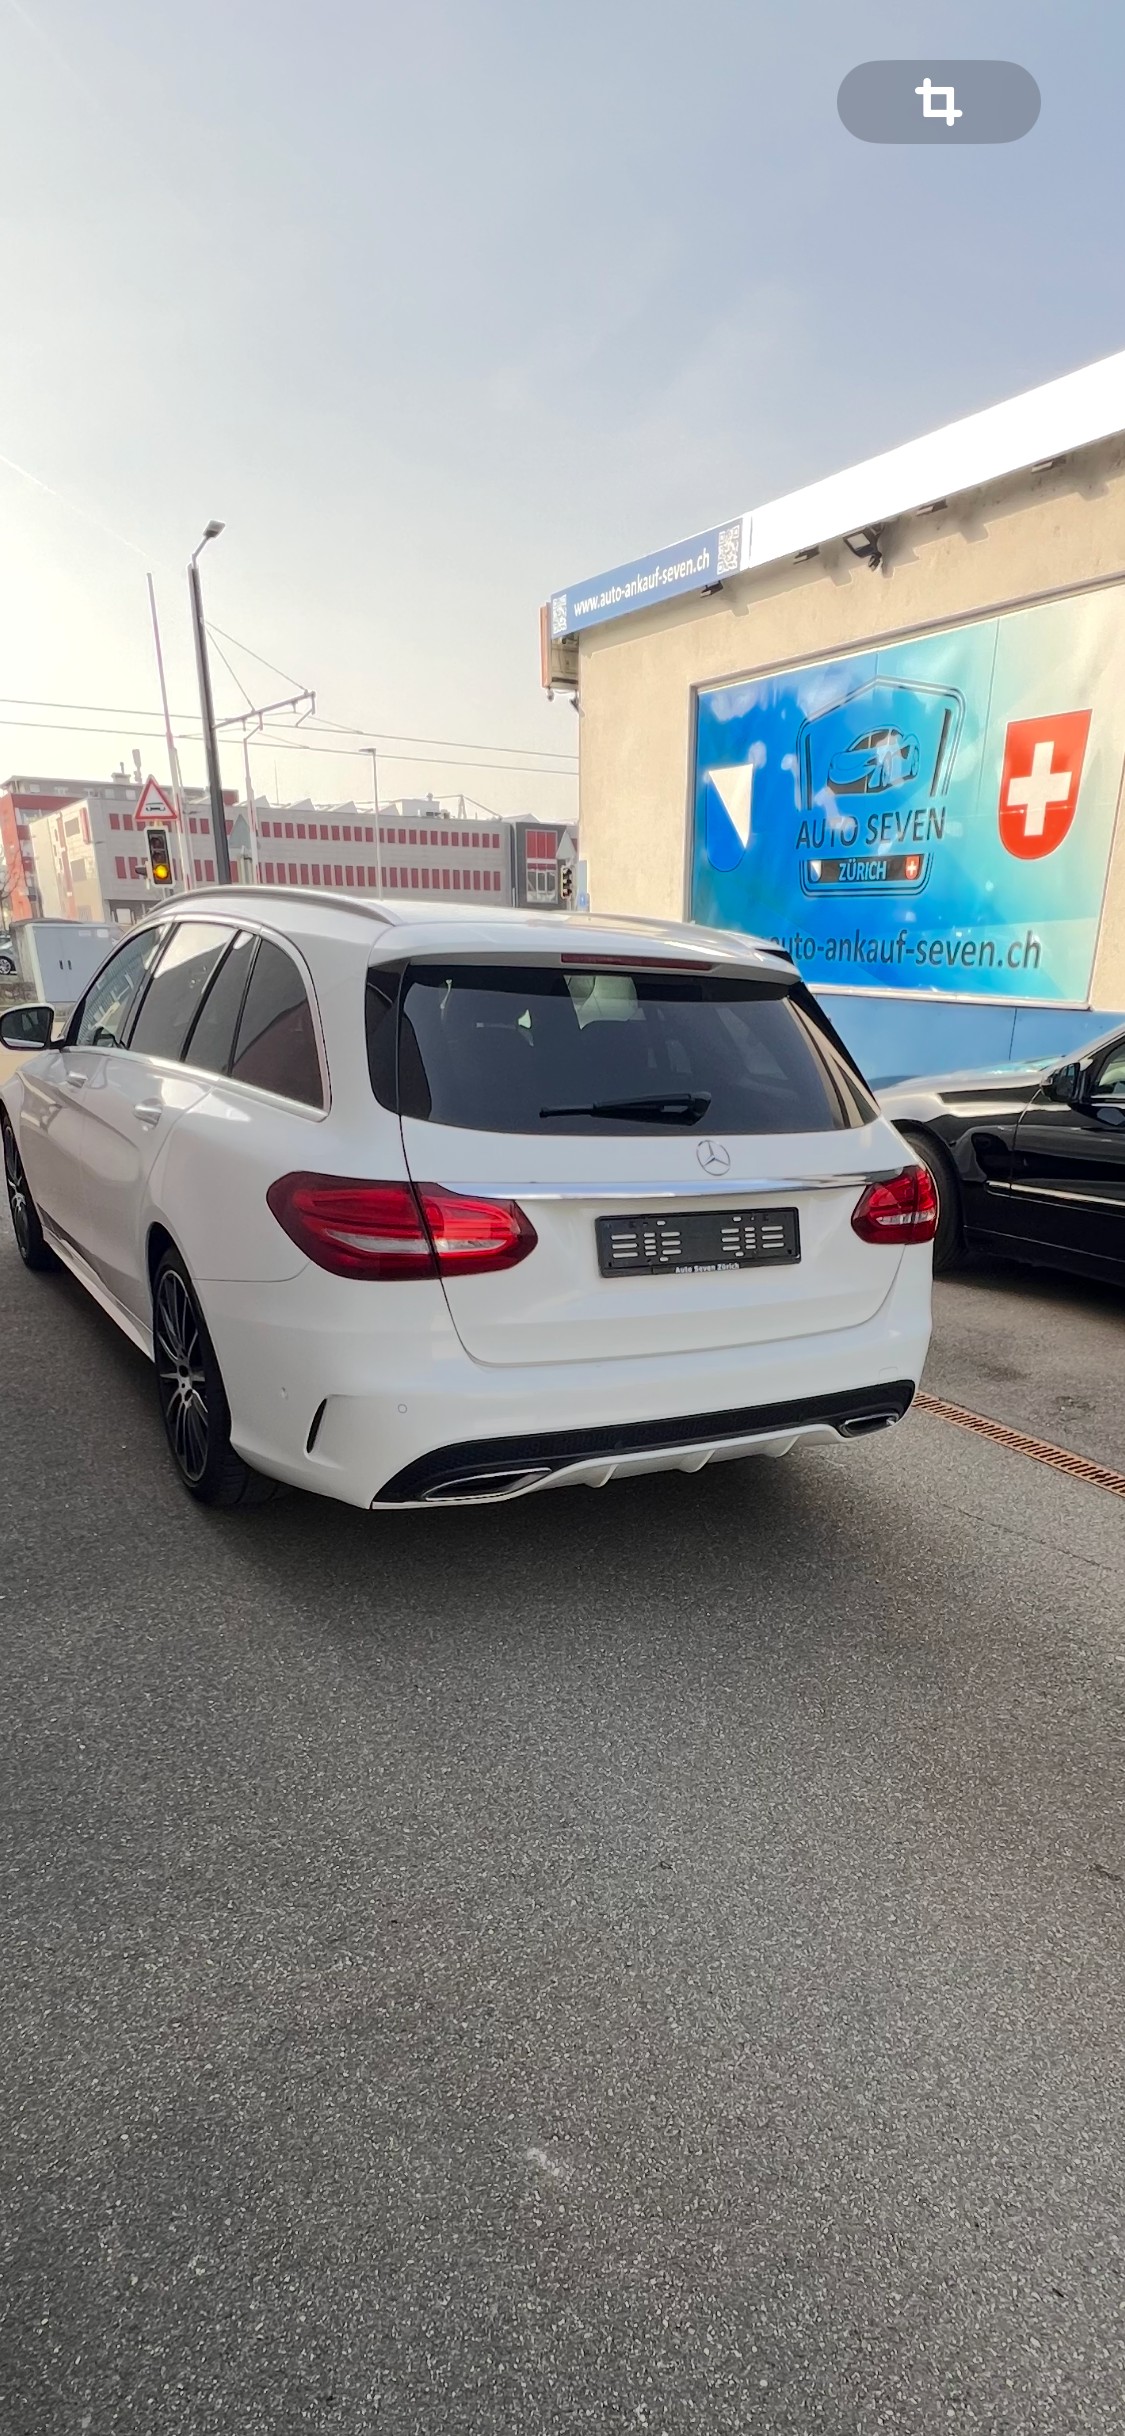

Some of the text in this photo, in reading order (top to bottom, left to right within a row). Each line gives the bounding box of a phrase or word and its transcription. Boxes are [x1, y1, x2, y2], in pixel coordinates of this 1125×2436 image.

[573, 547, 710, 617] www.auto-ankauf-seven.ch
[795, 806, 946, 850] AUTO SEVEN
[838, 859, 887, 881] ZÜRICH
[675, 1262, 740, 1274] Auto Seven Zürich
